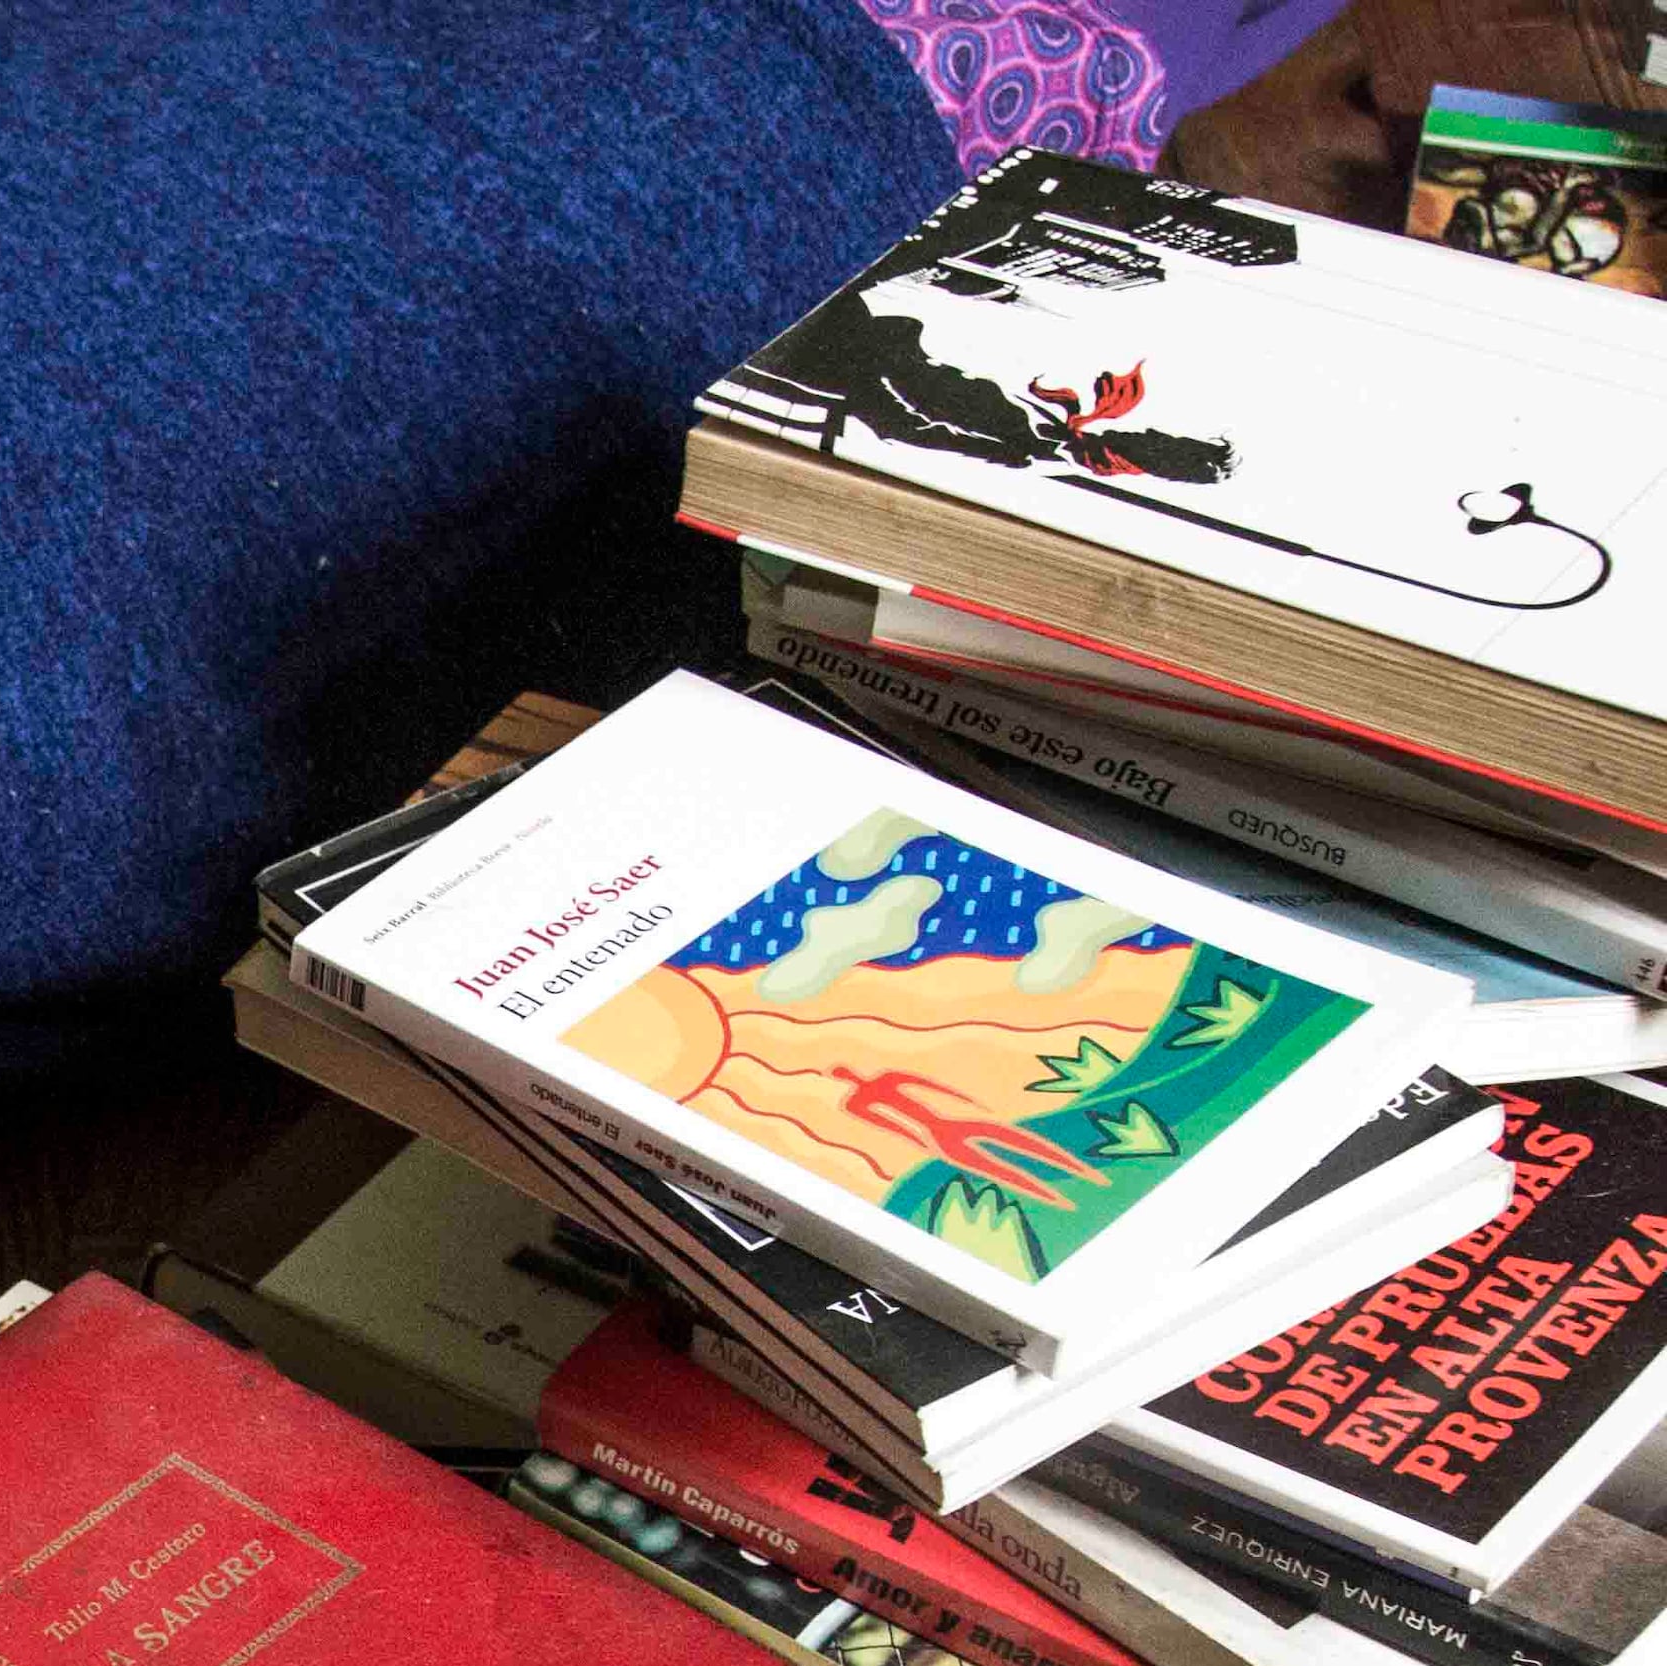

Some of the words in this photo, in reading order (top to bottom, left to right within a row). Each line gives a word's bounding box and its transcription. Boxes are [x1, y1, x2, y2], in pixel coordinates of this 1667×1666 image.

[777, 635, 940, 714] tremendo
[949, 702, 1001, 733] sol
[1008, 724, 1083, 766] este
[1094, 754, 1176, 809] Bajo
[1228, 809, 1346, 865] BUSQUED
[363, 926, 392, 945] Seix
[390, 899, 428, 928] Barral
[453, 942, 537, 1000] Juan
[525, 897, 600, 950] José
[589, 853, 663, 904] Saer
[498, 992, 545, 1021] El
[542, 901, 673, 994] entenado
[1323, 1378, 1440, 1465] EN
[1410, 1255, 1573, 1390] ALTA
[1393, 1213, 1667, 1496] PROVENZA
[1253, 1355, 1370, 1438] DE
[593, 1443, 674, 1496] Martín
[683, 1484, 800, 1555] Caparrós
[44, 1601, 103, 1642] Tulio
[99, 1578, 133, 1603] M.
[129, 1522, 206, 1579] Cestero
[1000, 1534, 1083, 1601] onda
[1190, 1514, 1330, 1588] ENRIQUEZ
[133, 1539, 275, 1653] SANGRE
[832, 1555, 931, 1622] Amor
[936, 1608, 961, 1635] y
[1341, 1579, 1468, 1650] MARIANA
